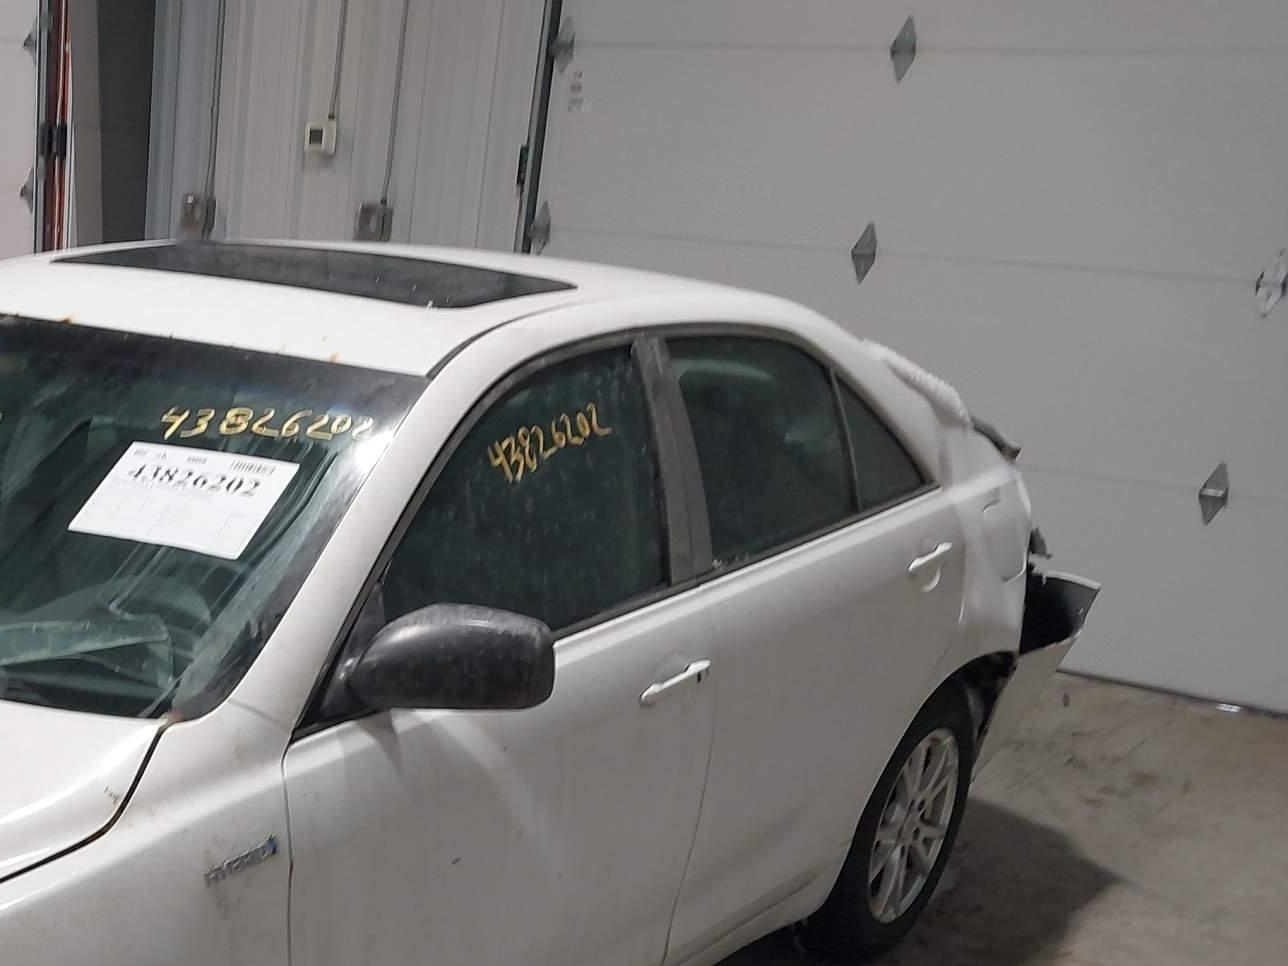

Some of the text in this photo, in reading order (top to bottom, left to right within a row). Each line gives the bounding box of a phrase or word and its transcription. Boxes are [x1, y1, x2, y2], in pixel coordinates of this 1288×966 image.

[160, 405, 376, 441] 43826202
[487, 402, 613, 484] 43826202
[128, 463, 261, 498] 43826202
